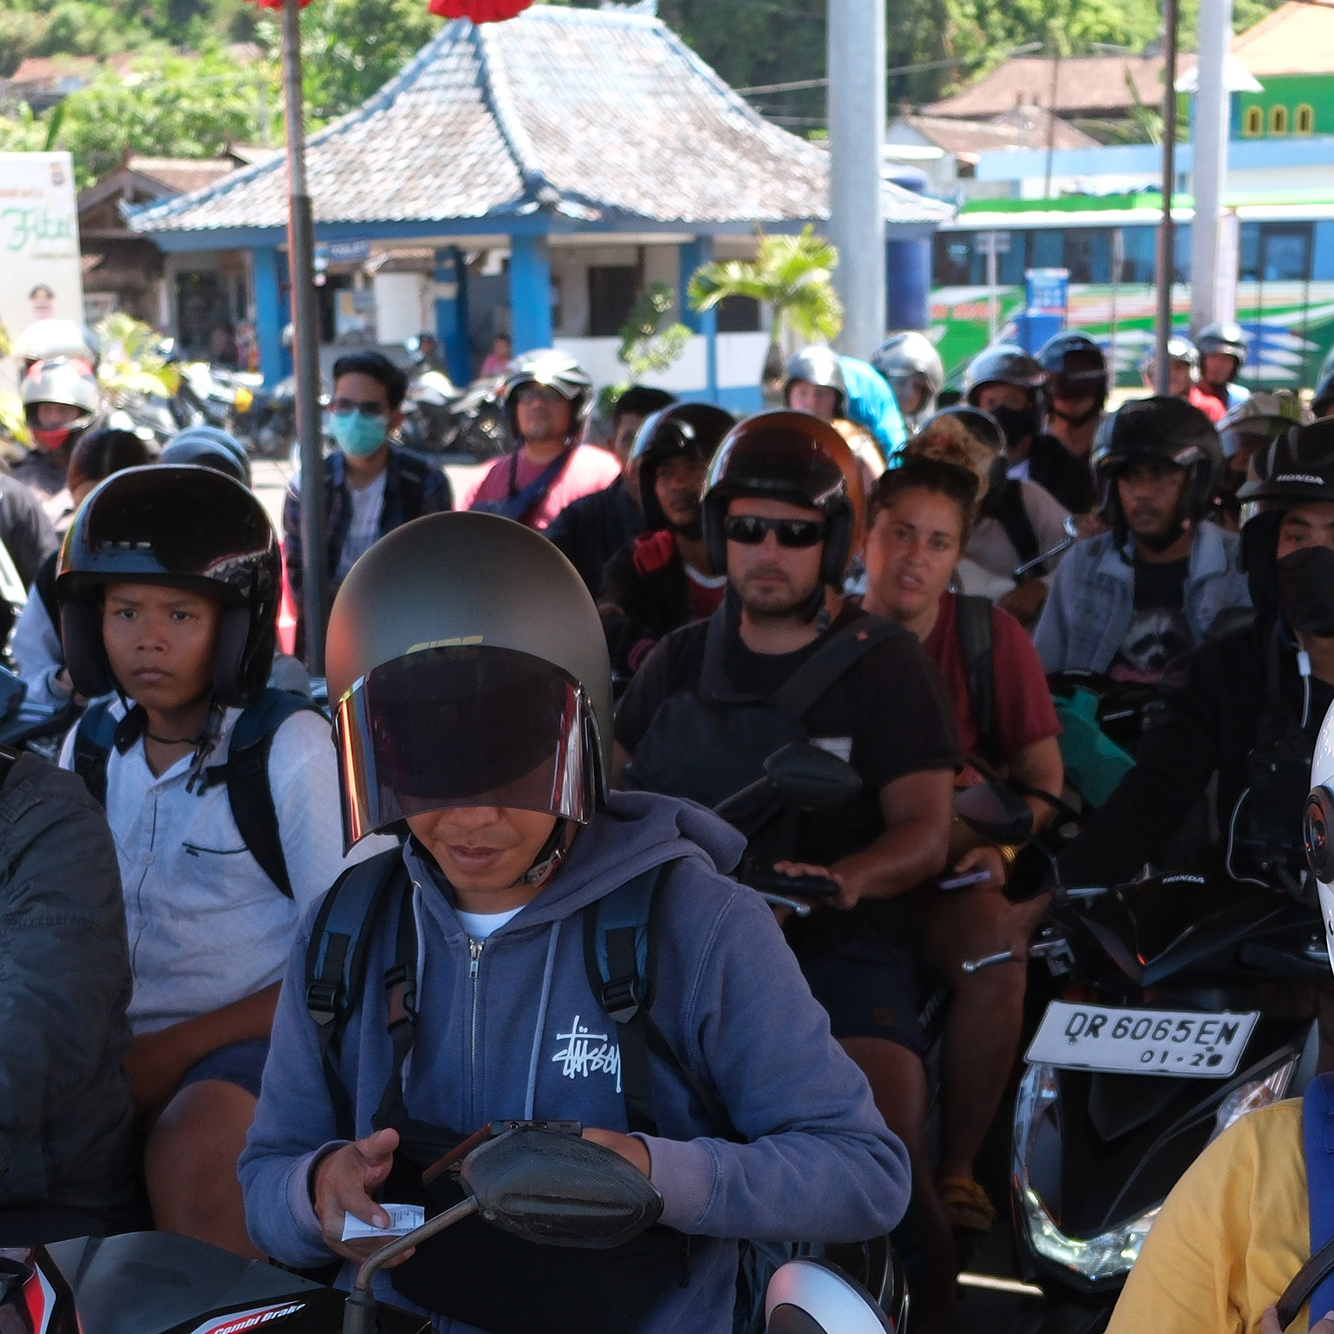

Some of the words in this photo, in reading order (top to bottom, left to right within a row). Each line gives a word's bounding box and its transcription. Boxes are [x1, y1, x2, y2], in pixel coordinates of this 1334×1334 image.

[1275, 472, 1325, 486] HONDA
[1162, 874, 1205, 885] HONDA
[1064, 1012, 1109, 1039] DR
[1111, 1016, 1197, 1044] 6065
[1194, 1020, 1241, 1046] EN
